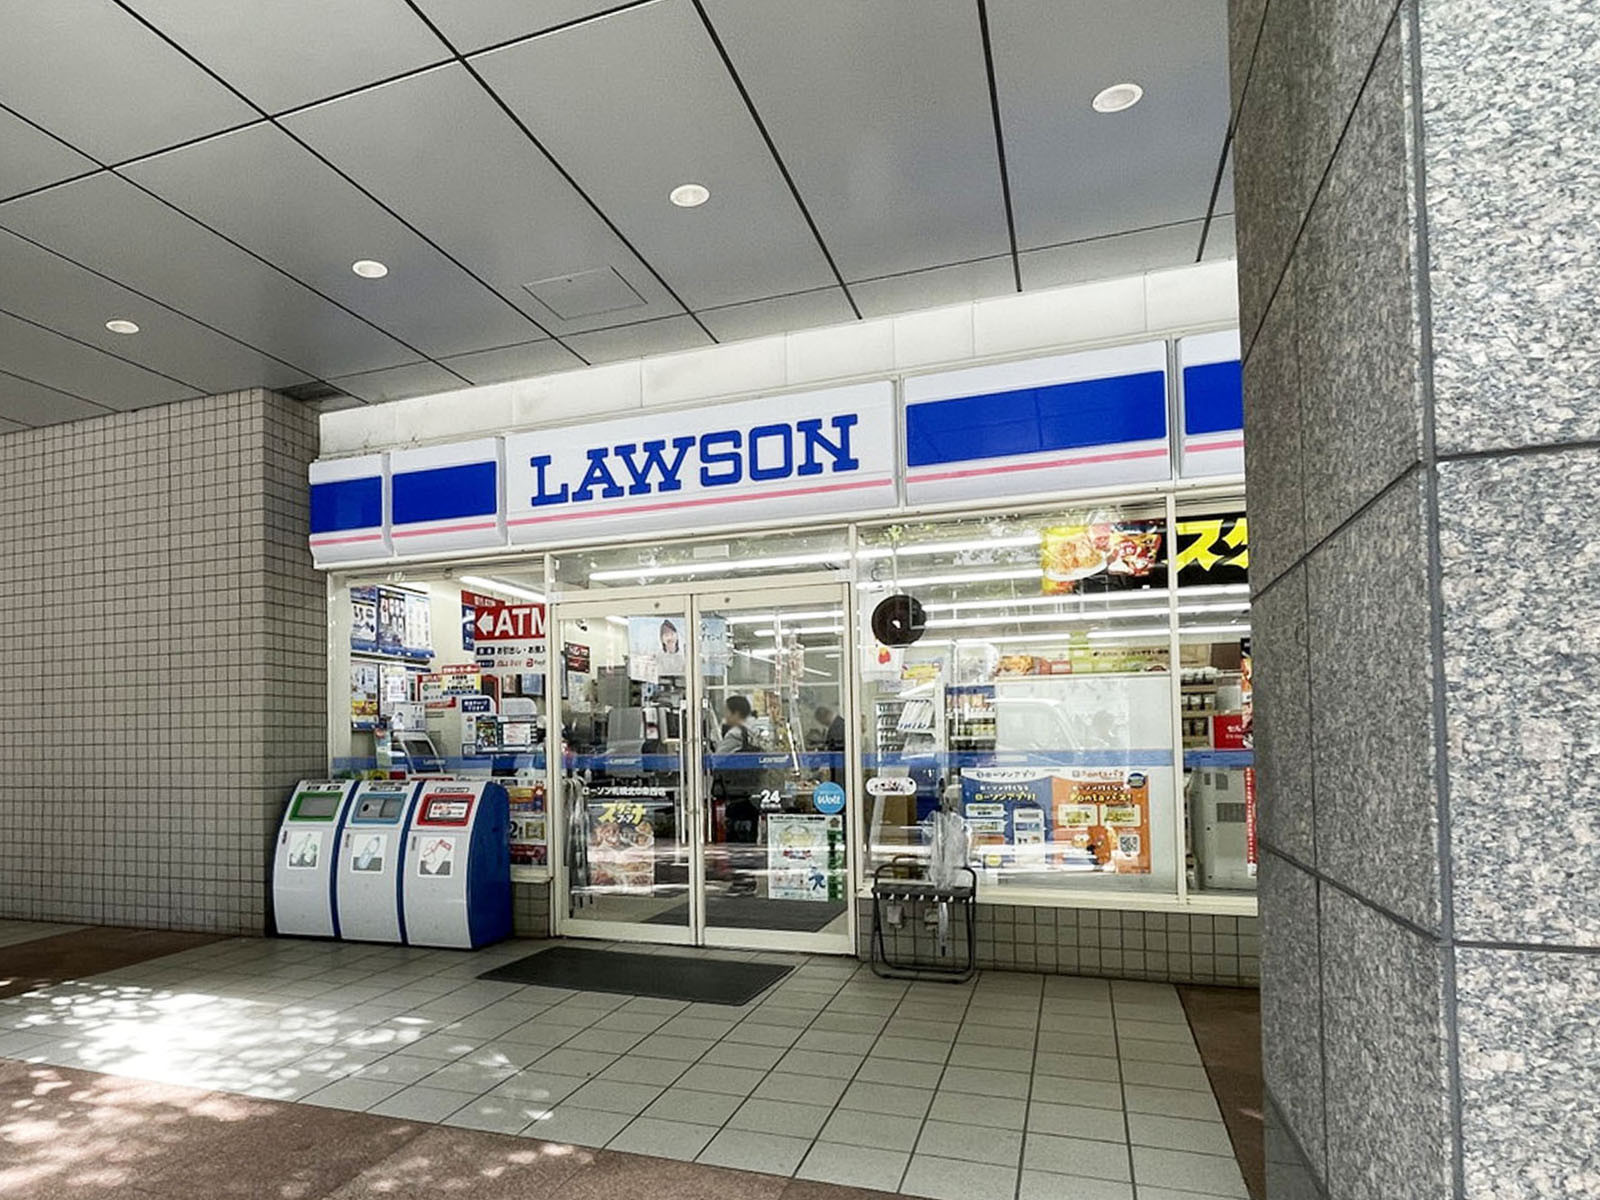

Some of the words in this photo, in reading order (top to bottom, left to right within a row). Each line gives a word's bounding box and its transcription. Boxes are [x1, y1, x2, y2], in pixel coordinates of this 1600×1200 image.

[530, 413, 859, 506] LAWSON
[494, 607, 546, 637] ATM
[761, 789, 781, 803] 24
